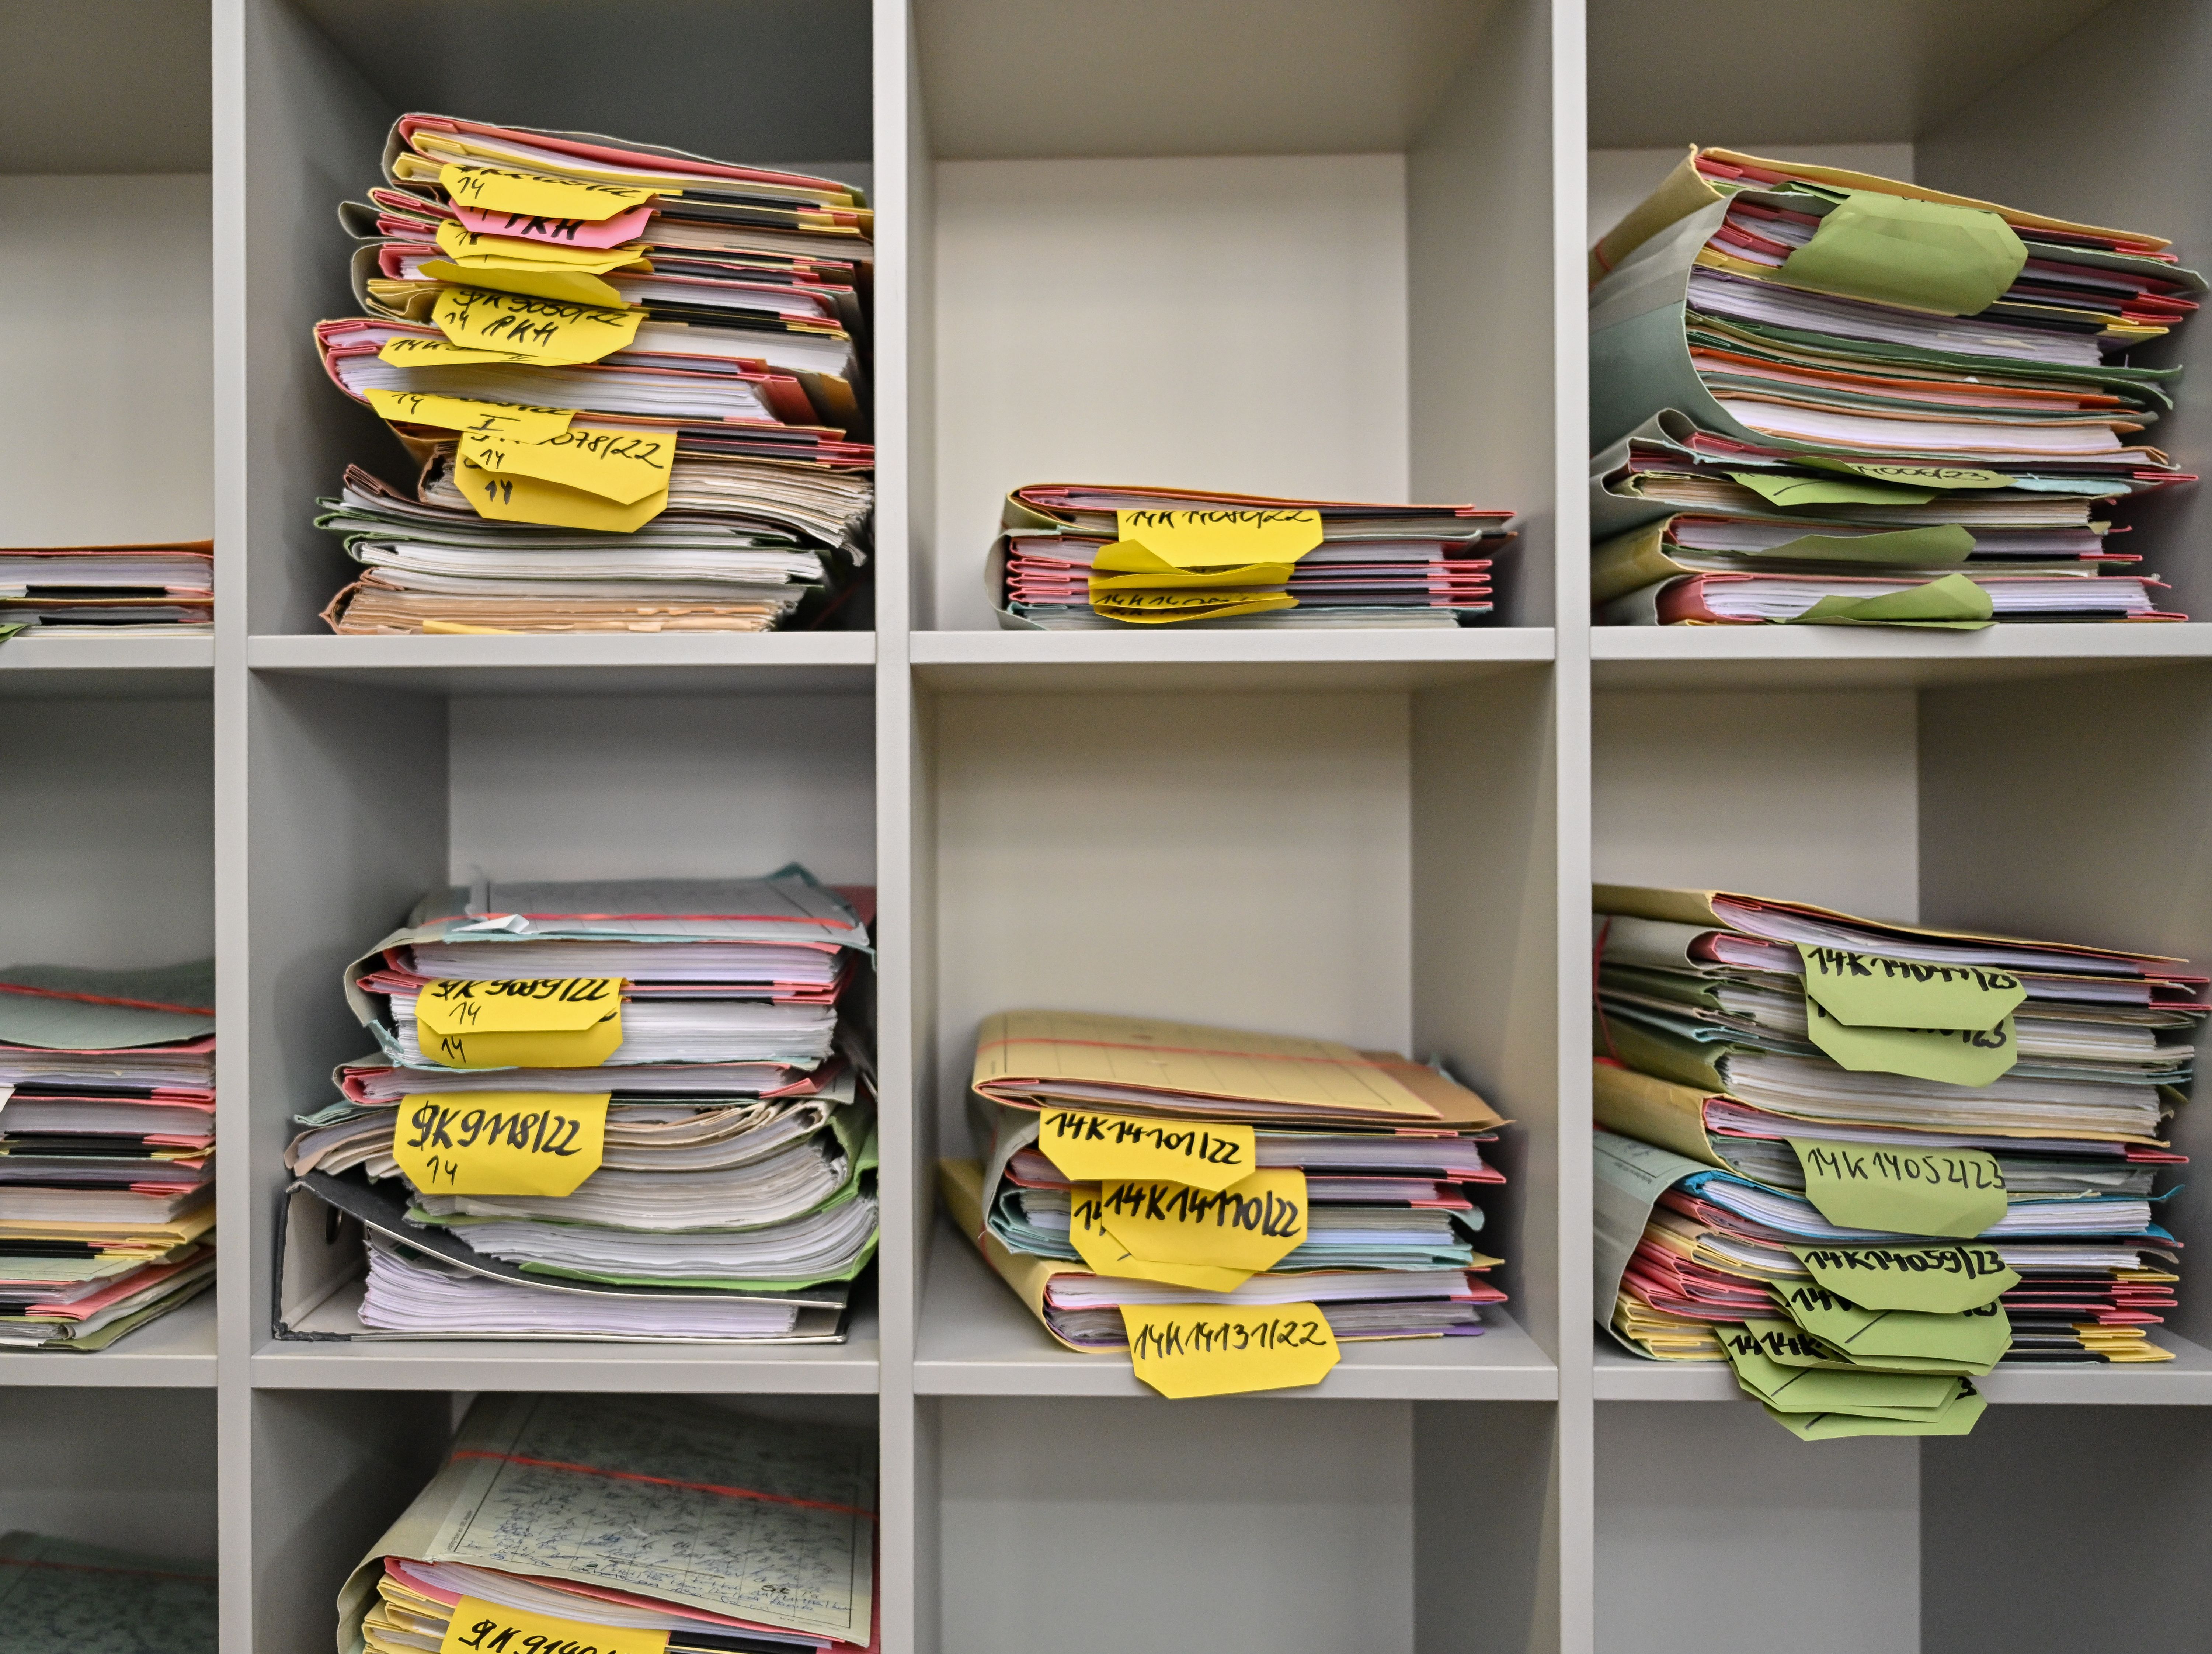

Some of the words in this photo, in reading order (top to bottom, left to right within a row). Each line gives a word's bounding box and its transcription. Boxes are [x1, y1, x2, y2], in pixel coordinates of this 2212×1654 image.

[457, 176, 485, 199] 14
[445, 309, 469, 331] 14
[481, 315, 559, 347] PKH
[392, 393, 425, 415] 14
[480, 449, 505, 470] 14
[536, 431, 664, 469] 078/22
[484, 479, 513, 505] 14
[449, 1001, 482, 1025] 14
[441, 1035, 467, 1063] 14
[427, 1154, 458, 1185] 14
